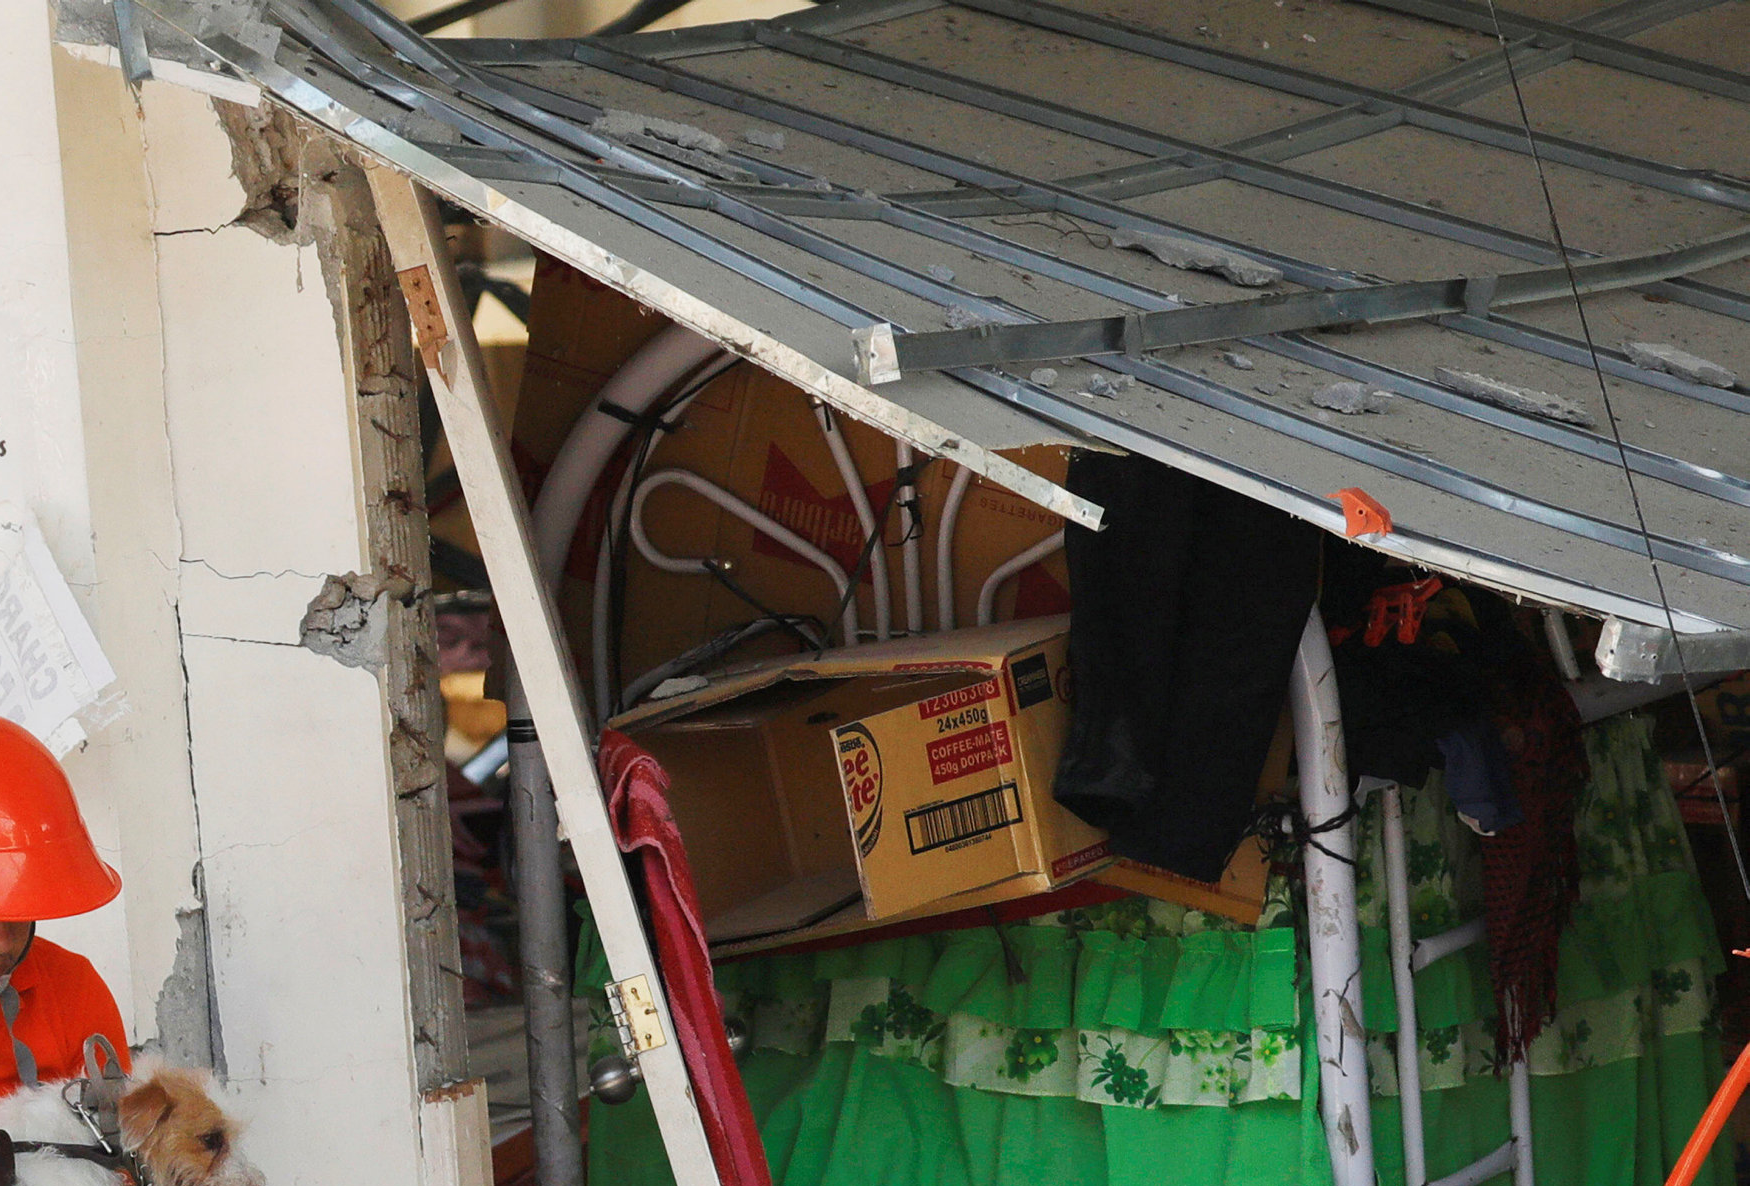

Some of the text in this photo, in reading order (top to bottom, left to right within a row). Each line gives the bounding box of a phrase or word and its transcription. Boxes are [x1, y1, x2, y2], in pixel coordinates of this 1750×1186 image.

[936, 706, 988, 733] 24x450g
[931, 729, 1005, 760] COFFEE-MATE
[933, 745, 1008, 776] 450g DOYPACK
